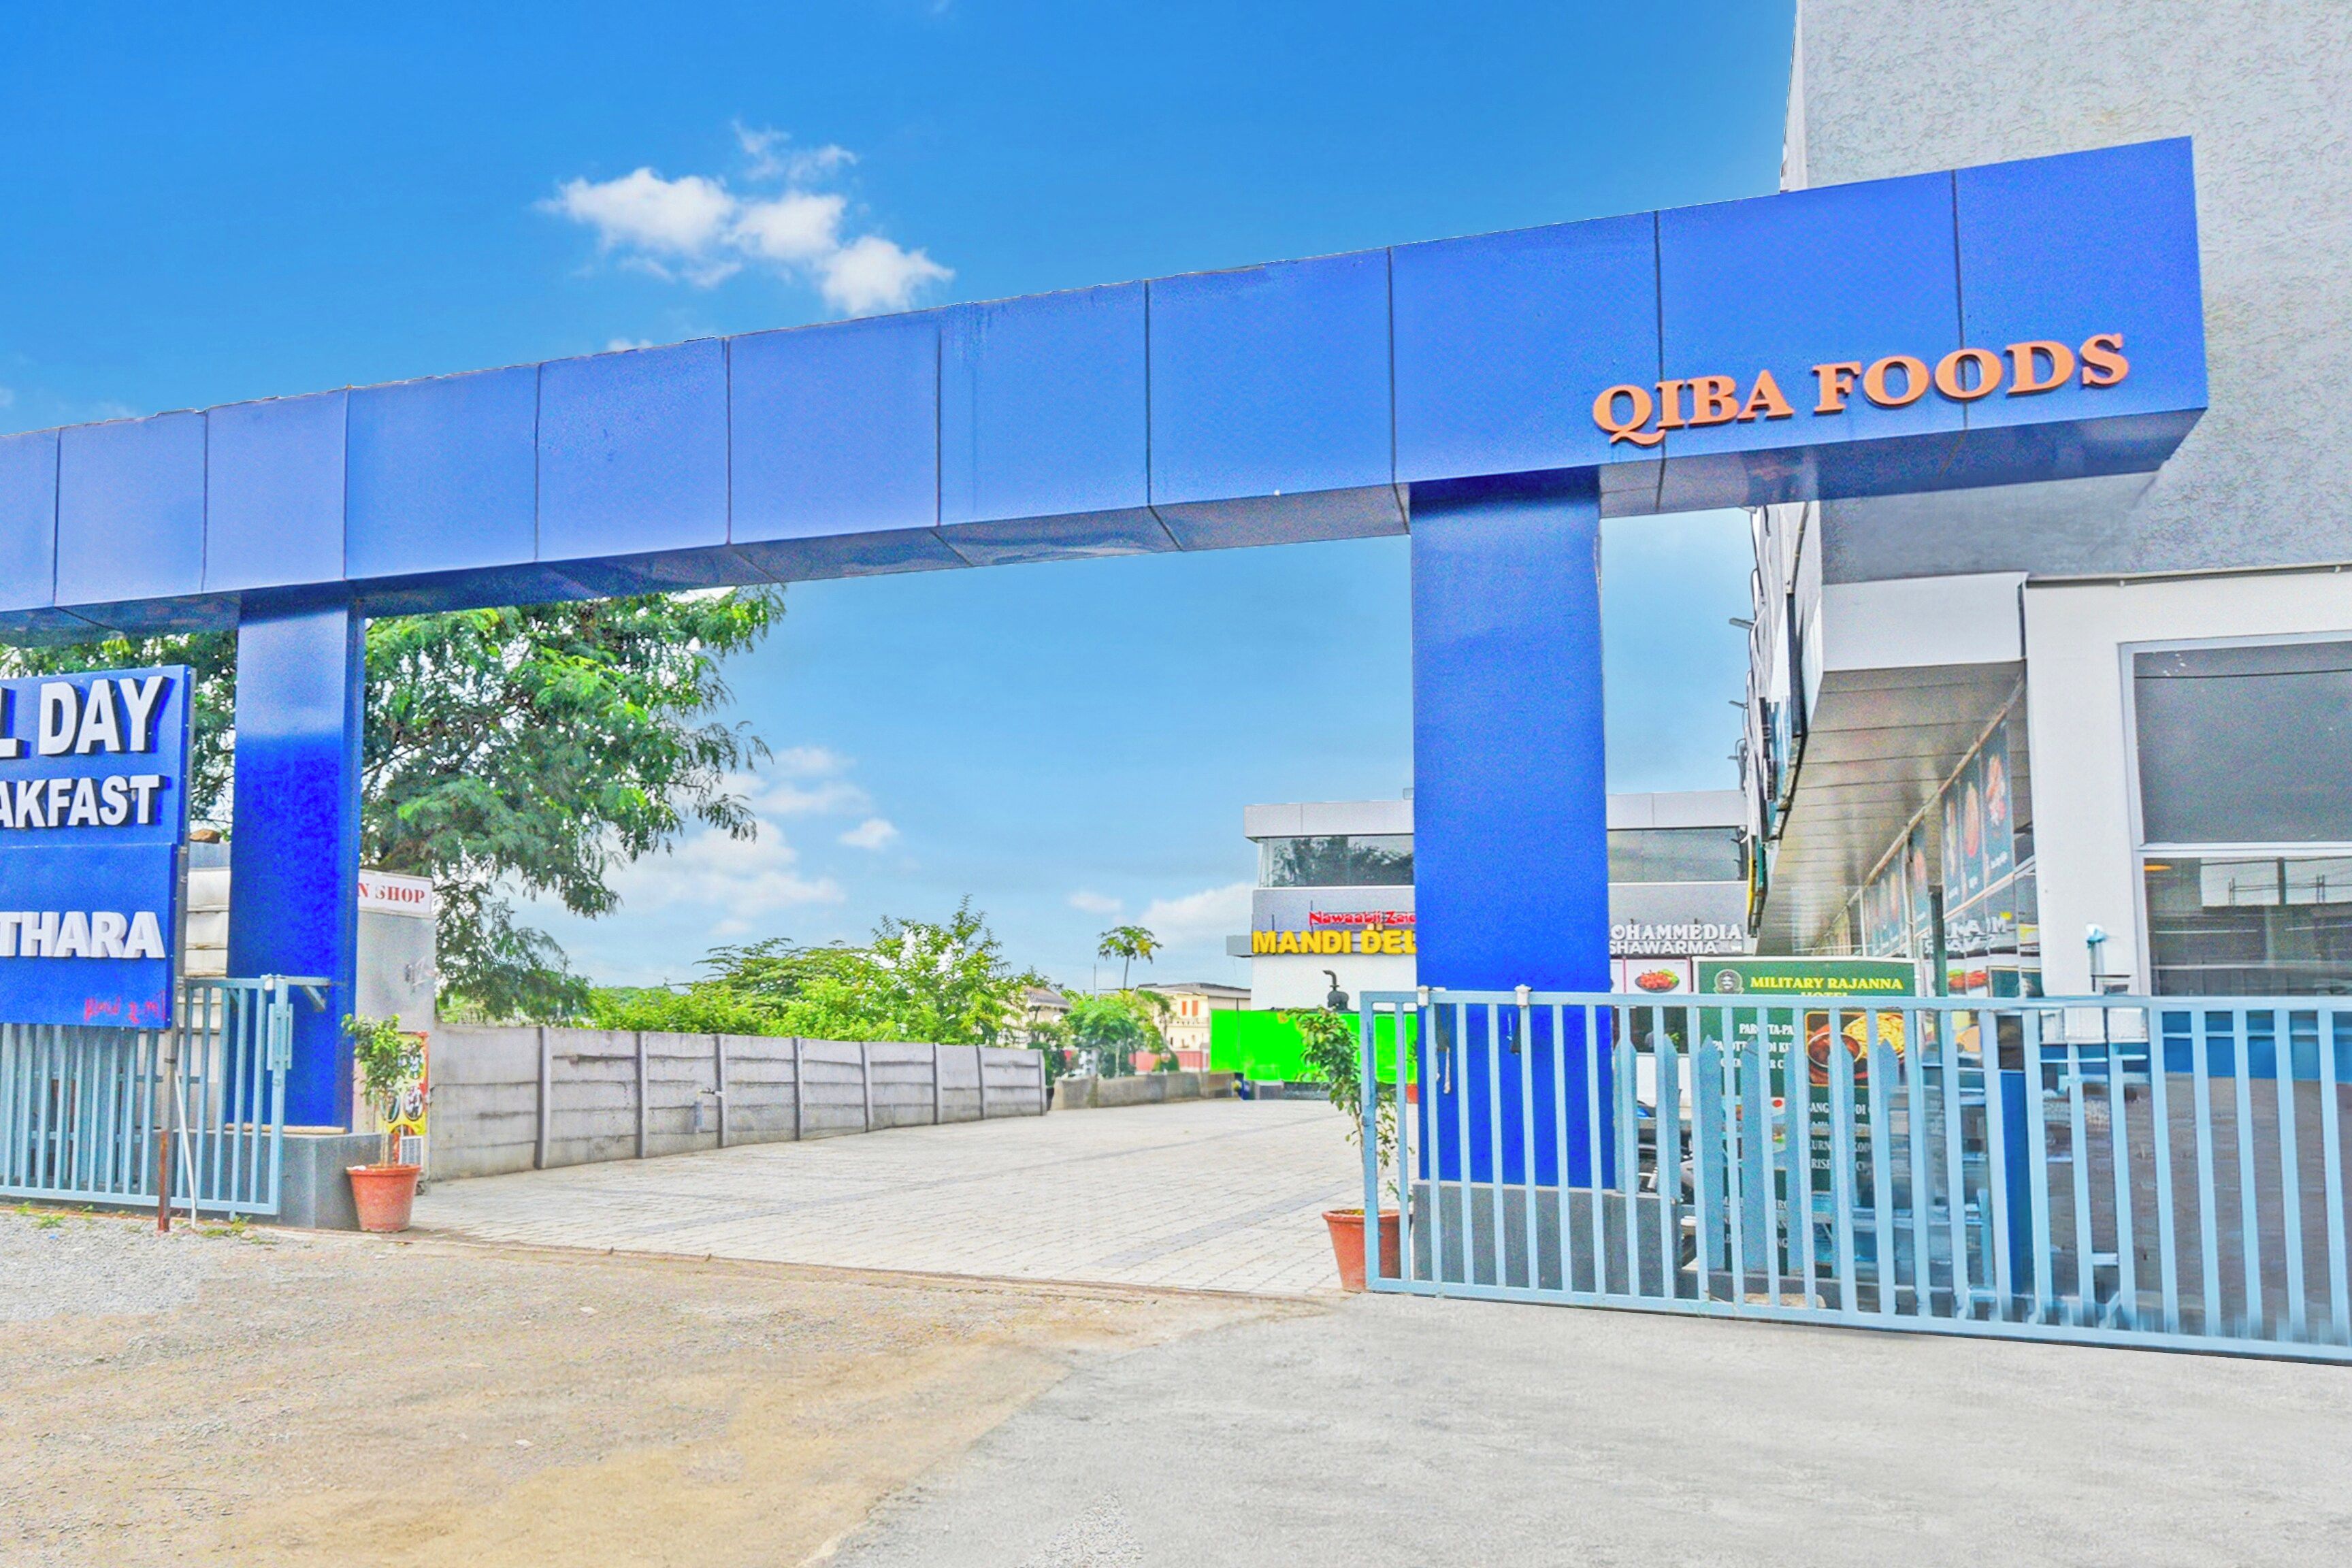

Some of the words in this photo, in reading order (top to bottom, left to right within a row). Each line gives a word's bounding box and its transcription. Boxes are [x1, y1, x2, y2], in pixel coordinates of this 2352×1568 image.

[1592, 369, 1795, 446] QIBA
[1812, 333, 2130, 414] FOODS
[38, 675, 164, 756] DAY
[375, 885, 425, 904] SHOP
[1252, 929, 1352, 955] MANDI
[1610, 940, 1719, 955] SHAWARMA
[1750, 976, 1825, 990] MILITARY
[1827, 977, 1904, 990] RAJANNA
